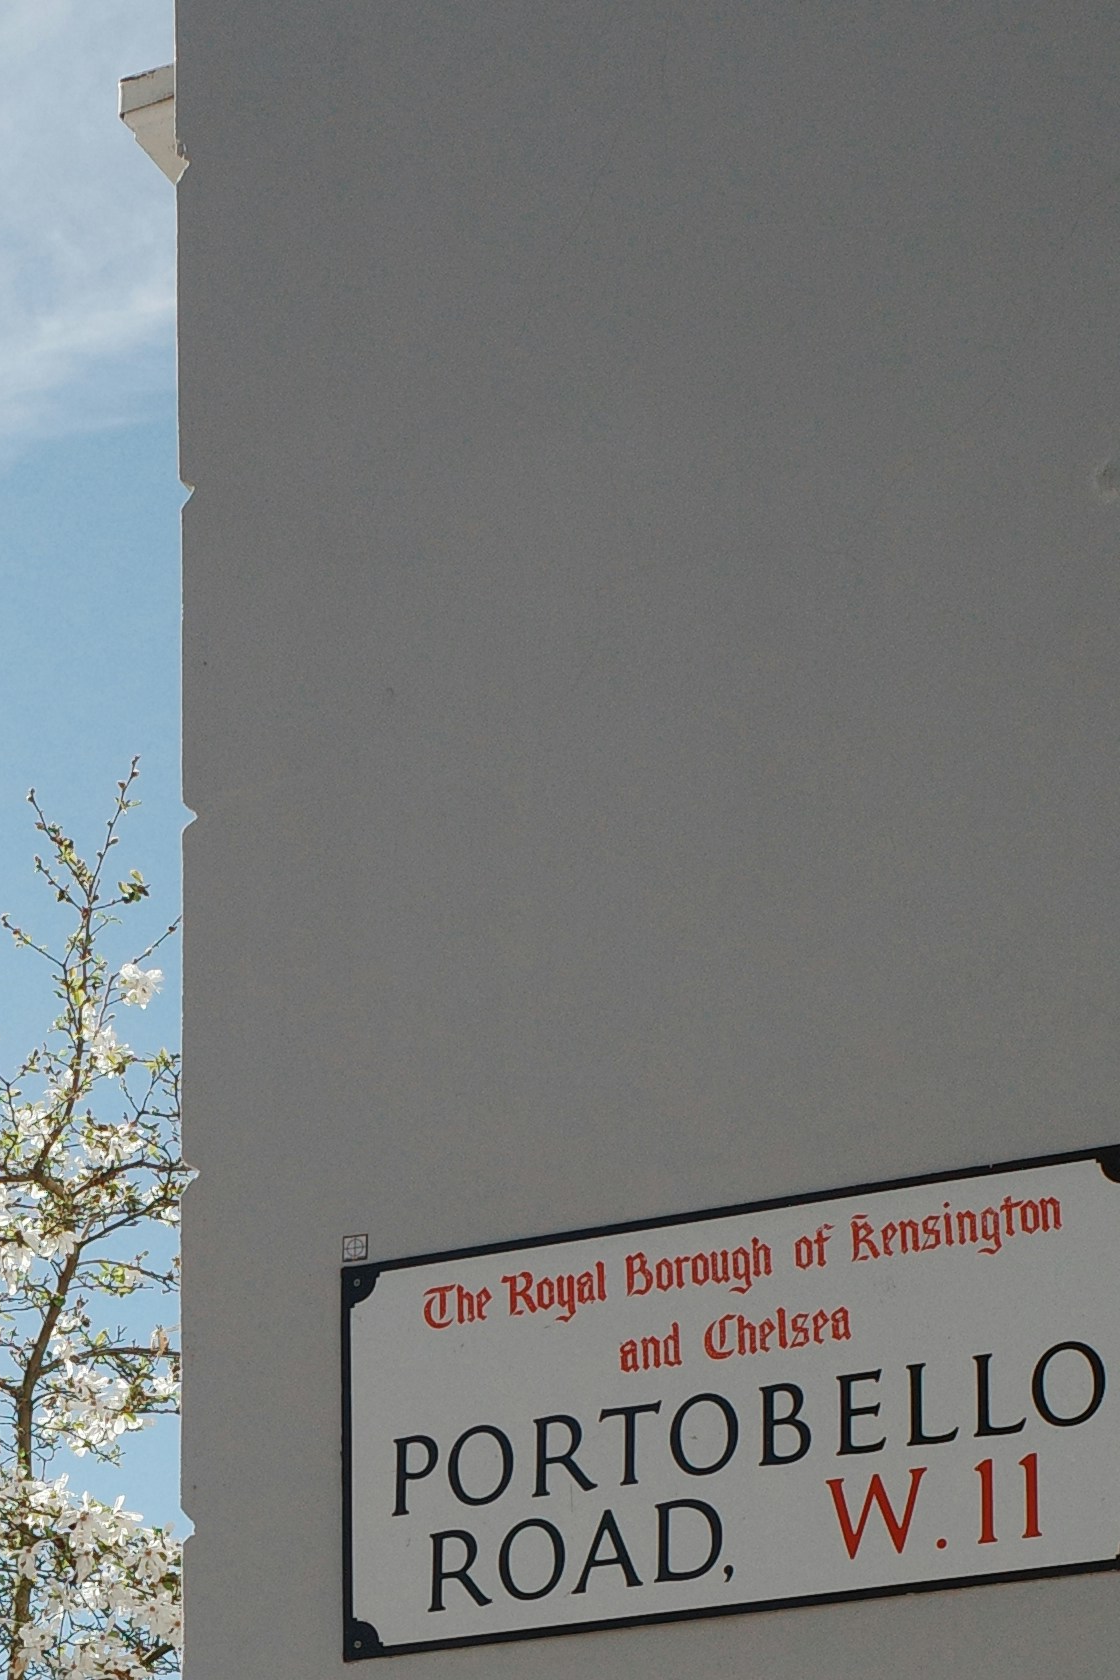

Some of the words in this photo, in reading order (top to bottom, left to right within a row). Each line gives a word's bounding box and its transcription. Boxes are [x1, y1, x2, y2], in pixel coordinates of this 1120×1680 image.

[423, 1283, 492, 1330] The
[500, 1260, 608, 1323] Royal
[624, 1236, 773, 1297] Borough
[794, 1222, 833, 1270] of
[850, 1194, 1064, 1262] Kensington
[618, 1321, 683, 1374] and
[703, 1305, 852, 1361] Chelsea
[391, 1340, 1106, 1517] PORTOBELLO
[427, 1498, 734, 1613] ROAD,
